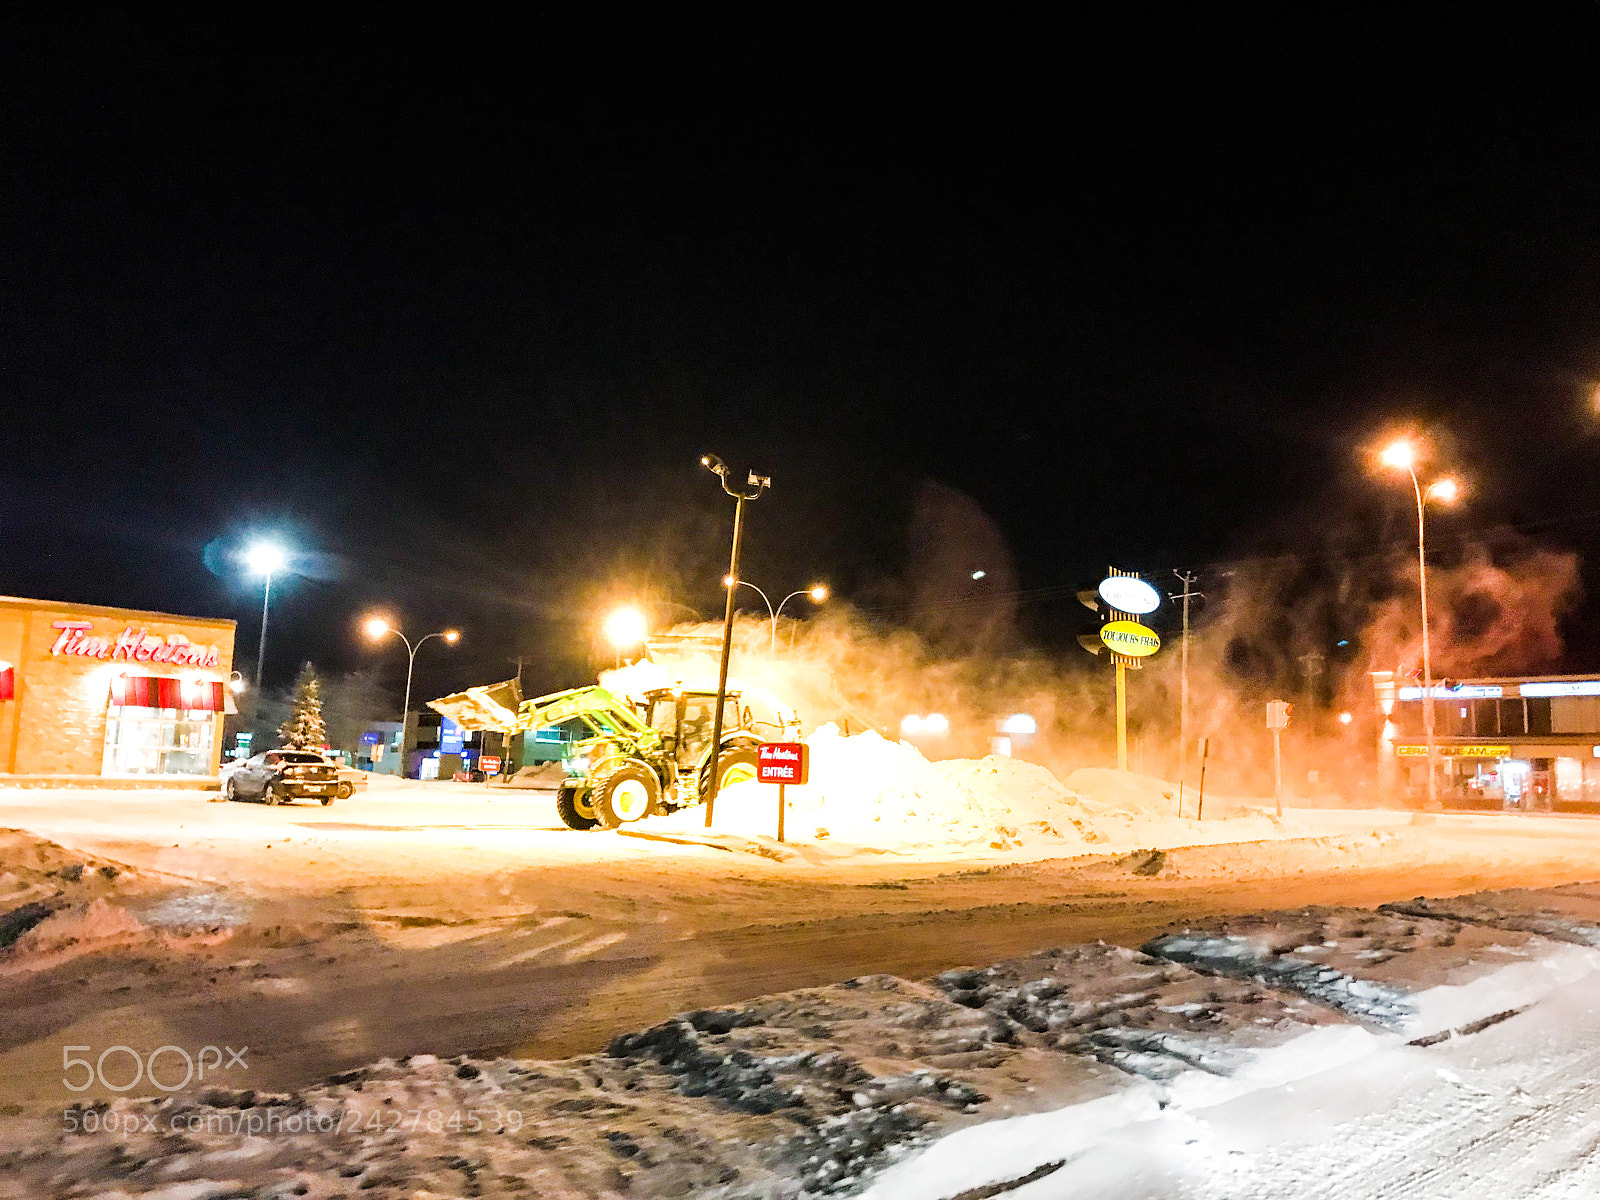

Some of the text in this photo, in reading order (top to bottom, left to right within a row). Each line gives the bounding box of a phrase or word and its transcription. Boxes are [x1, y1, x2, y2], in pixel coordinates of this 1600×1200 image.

[51, 620, 220, 668] Tim Hortons
[1103, 630, 1159, 647] TOUJOURS FRAIS
[760, 746, 773, 759] Tim
[762, 765, 793, 778] ENTRÉE
